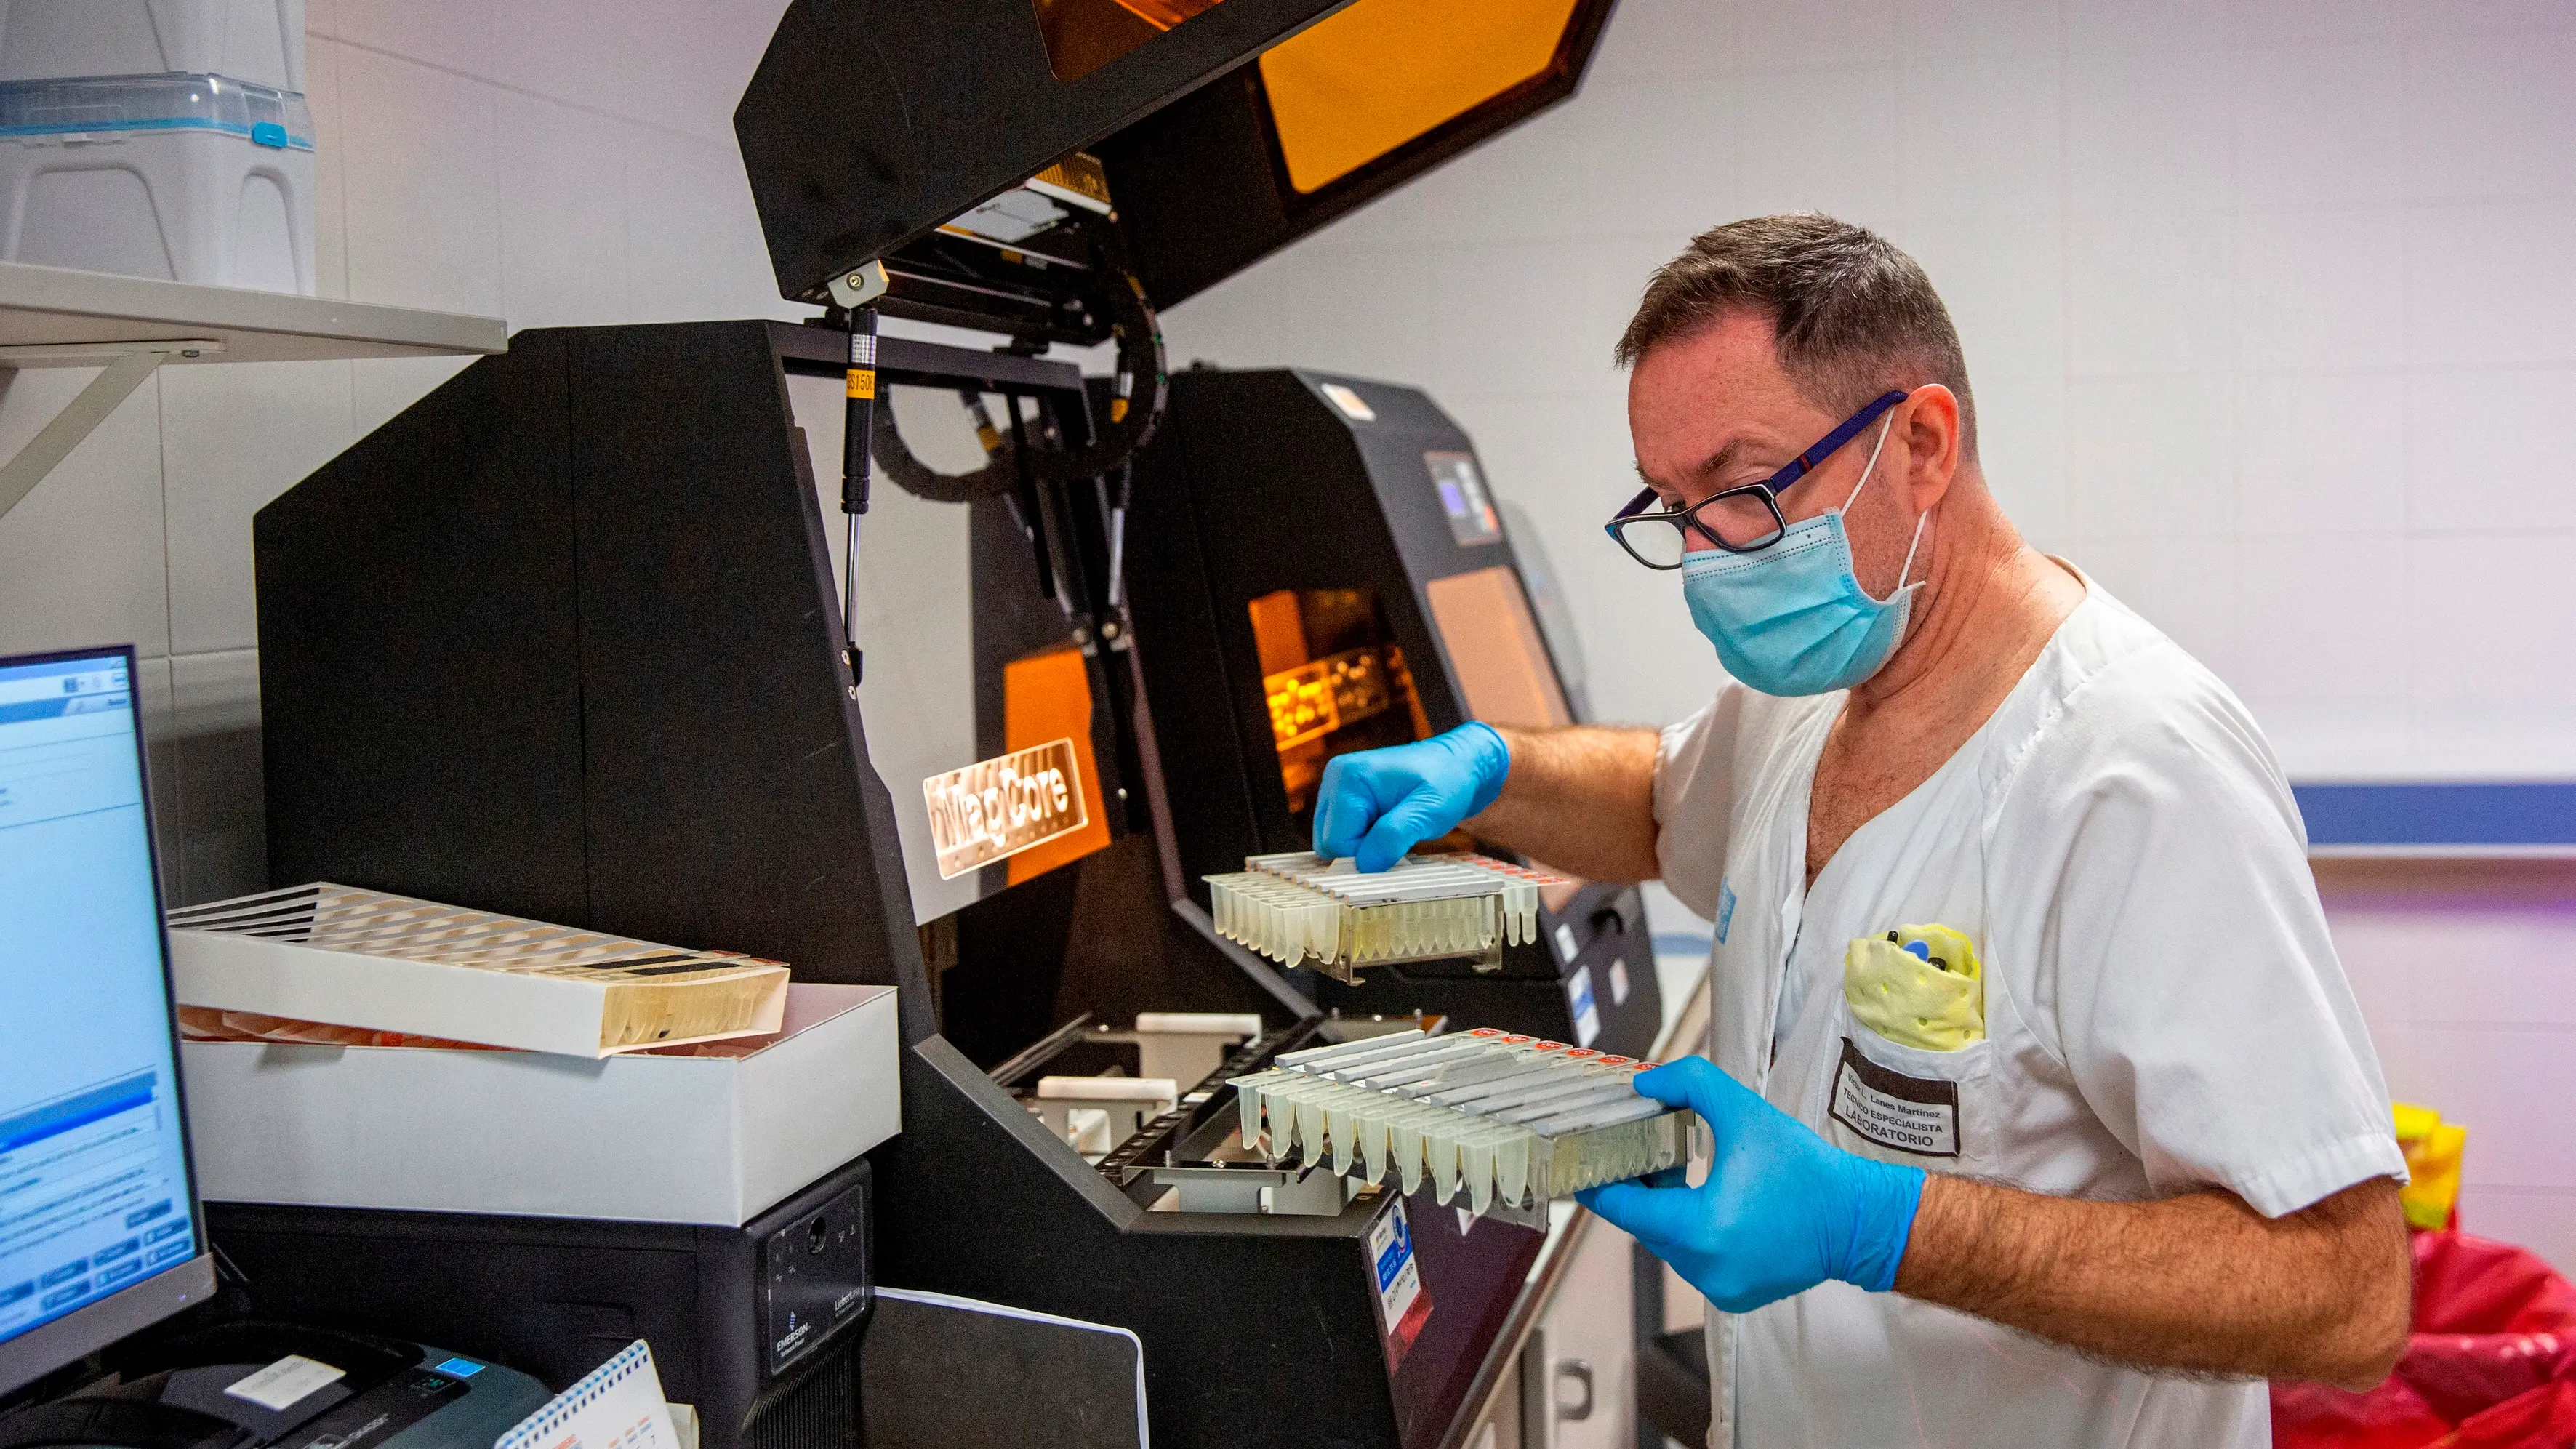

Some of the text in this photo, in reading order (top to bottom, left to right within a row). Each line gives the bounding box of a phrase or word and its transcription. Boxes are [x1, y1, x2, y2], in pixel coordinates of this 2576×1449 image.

[1870, 1094, 1895, 1111] Lanes
[1898, 1104, 1941, 1119] Martinez
[1845, 1104, 1934, 1147] LABORATORIO
[1871, 1109, 1943, 1133] ESPECIALISTA
[777, 1322, 808, 1352] EMERSON
